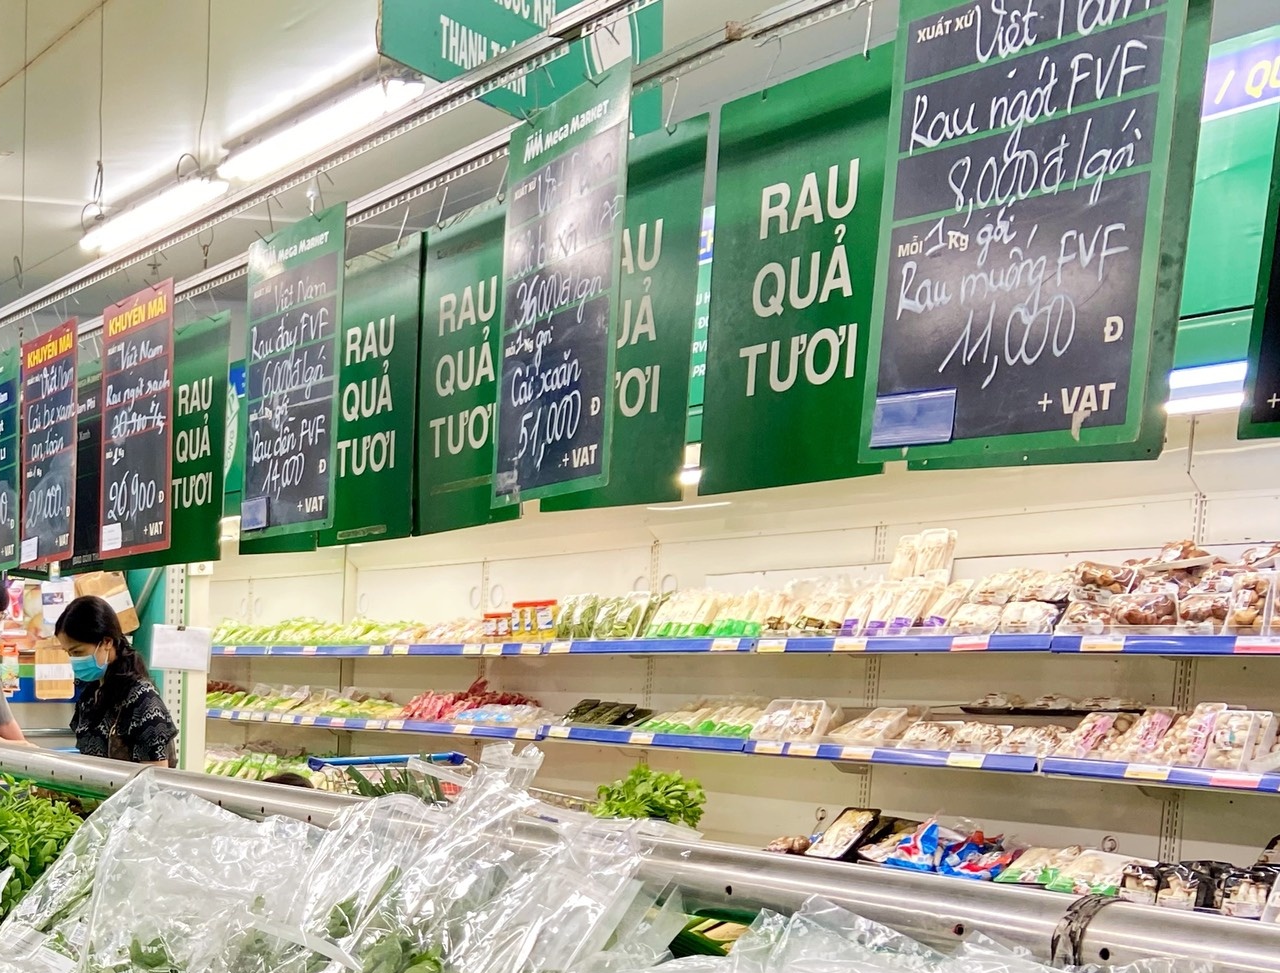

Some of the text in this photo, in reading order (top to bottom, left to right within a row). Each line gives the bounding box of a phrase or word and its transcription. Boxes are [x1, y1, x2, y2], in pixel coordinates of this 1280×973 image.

[440, 14, 487, 70] THANH
[916, 9, 974, 43] XUẤT XỨ
[909, 94, 979, 156] Rau
[1067, 39, 1148, 114] FVF
[759, 157, 860, 241] RAU
[898, 234, 923, 258] MỖI
[752, 224, 854, 318] QUẢ
[897, 261, 952, 320] Rau
[1056, 223, 1129, 287] FVF
[108, 291, 167, 337] KHUYẾN MÃI
[300, 307, 328, 345] FVF
[438, 275, 498, 337] RAU
[27, 334, 58, 369] KHUYẾN
[59, 328, 73, 354] MÃI
[345, 314, 396, 367] RAU
[435, 325, 495, 397] QUẢ
[739, 322, 858, 397] TƯƠI
[938, 294, 1124, 389] 11,000 Đ
[177, 376, 213, 417] RAU
[342, 359, 394, 422] QUẢ
[591, 396, 600, 416] Đ
[1038, 382, 1117, 415] + VAT
[175, 415, 212, 464] QUẢ
[299, 414, 326, 451] FVF
[337, 429, 396, 478] TƯƠI
[429, 402, 497, 459] TƯƠI
[572, 444, 597, 468] VAT
[172, 471, 213, 510] TƯƠI
[305, 495, 325, 513] VAT
[149, 521, 163, 536] VAT
